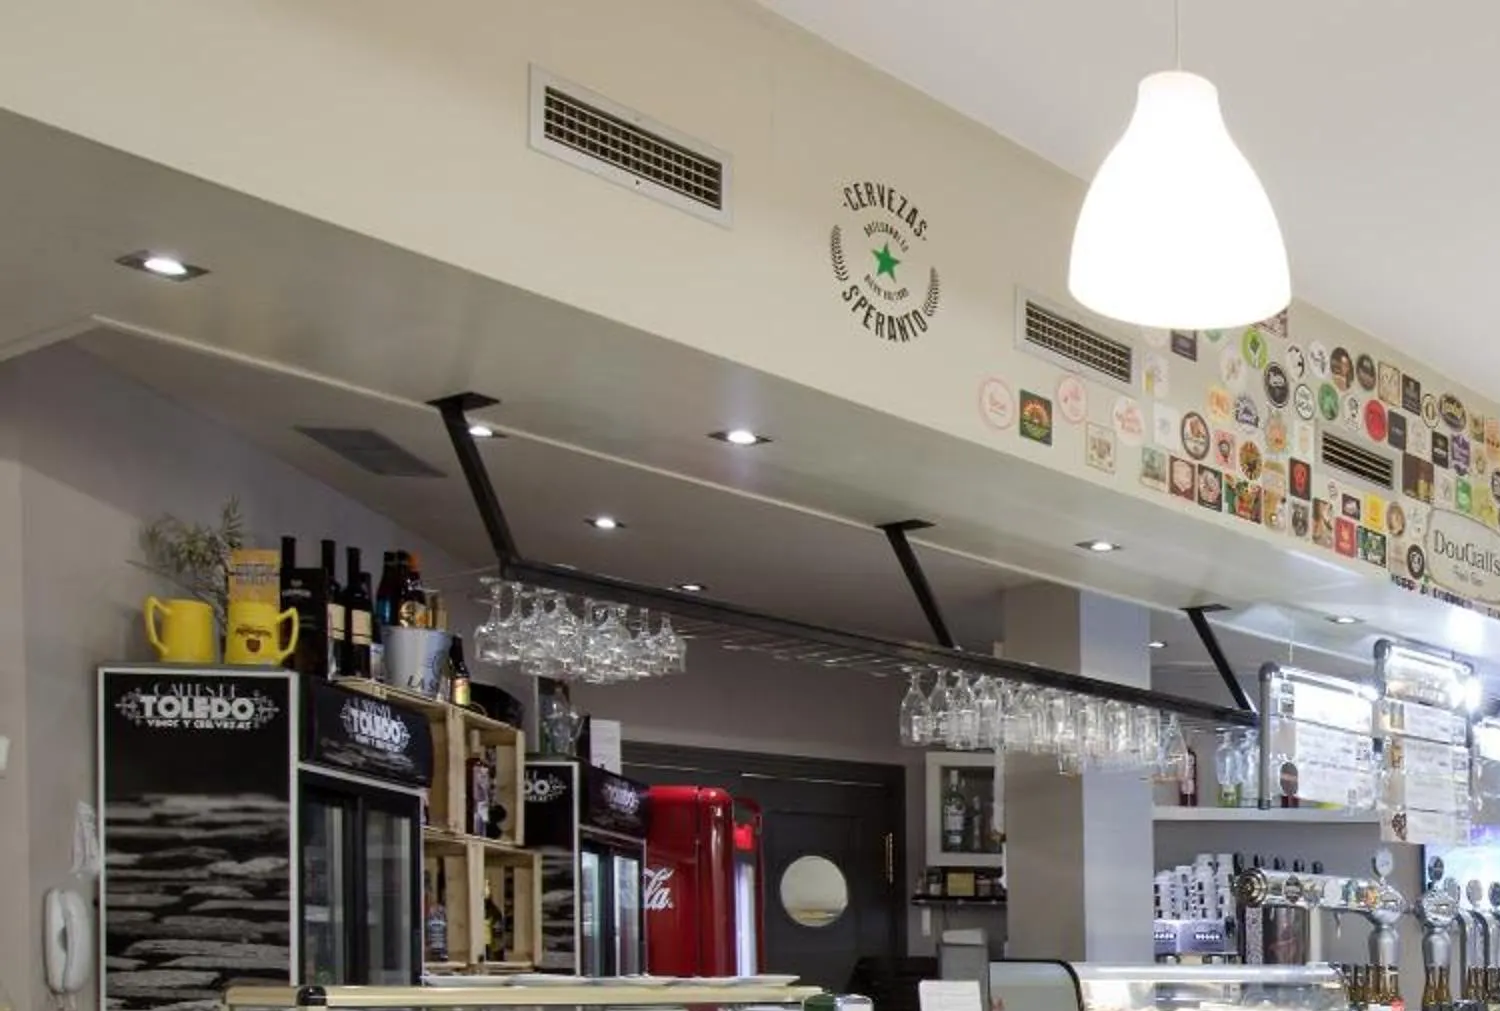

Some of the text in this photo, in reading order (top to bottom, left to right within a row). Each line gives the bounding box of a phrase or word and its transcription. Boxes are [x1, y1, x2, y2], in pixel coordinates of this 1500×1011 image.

[843, 182, 928, 238] CERVEZAS
[842, 285, 928, 343] SPERANTO
[139, 695, 255, 721] TOLEDO
[183, 719, 192, 729] Y
[350, 707, 402, 745] TOLEDO
